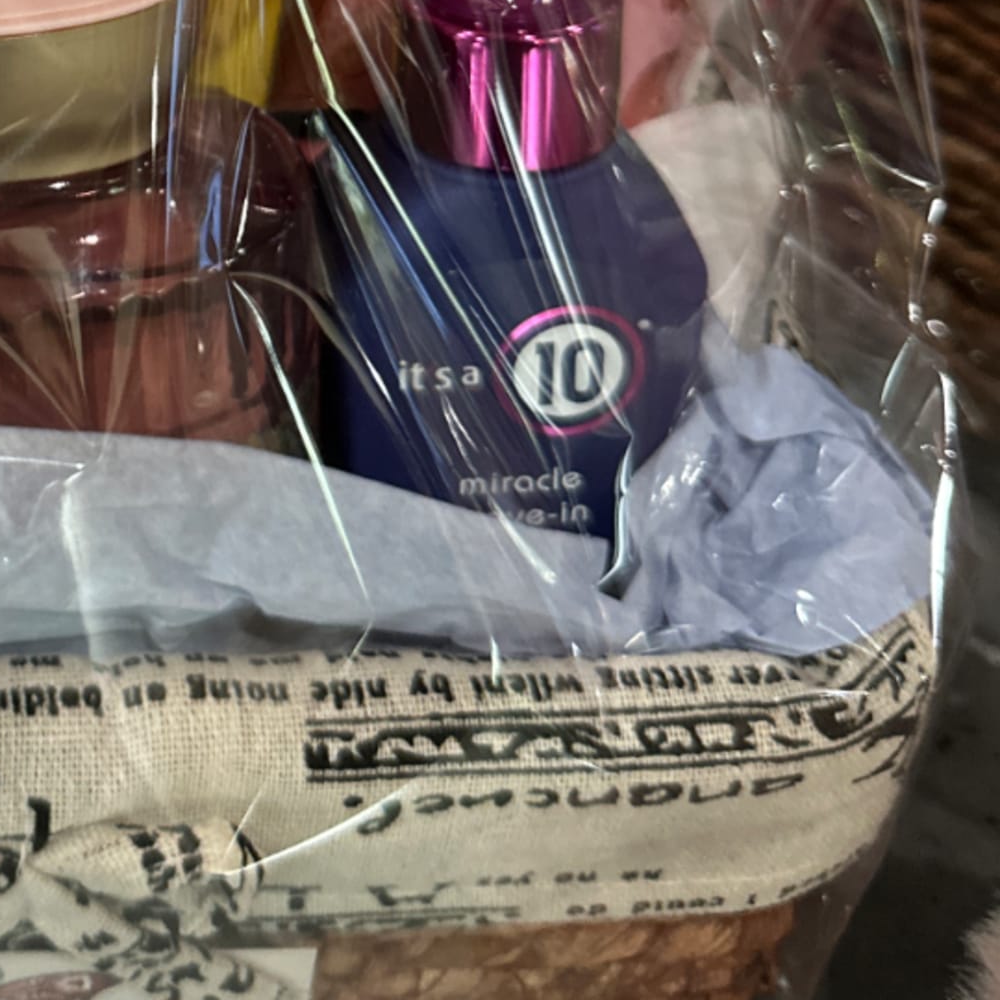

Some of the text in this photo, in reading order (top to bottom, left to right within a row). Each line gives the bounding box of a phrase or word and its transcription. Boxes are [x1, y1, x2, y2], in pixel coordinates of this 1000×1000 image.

[533, 338, 606, 405] 10
[459, 468, 584, 497] miracle
[410, 669, 455, 702] by
